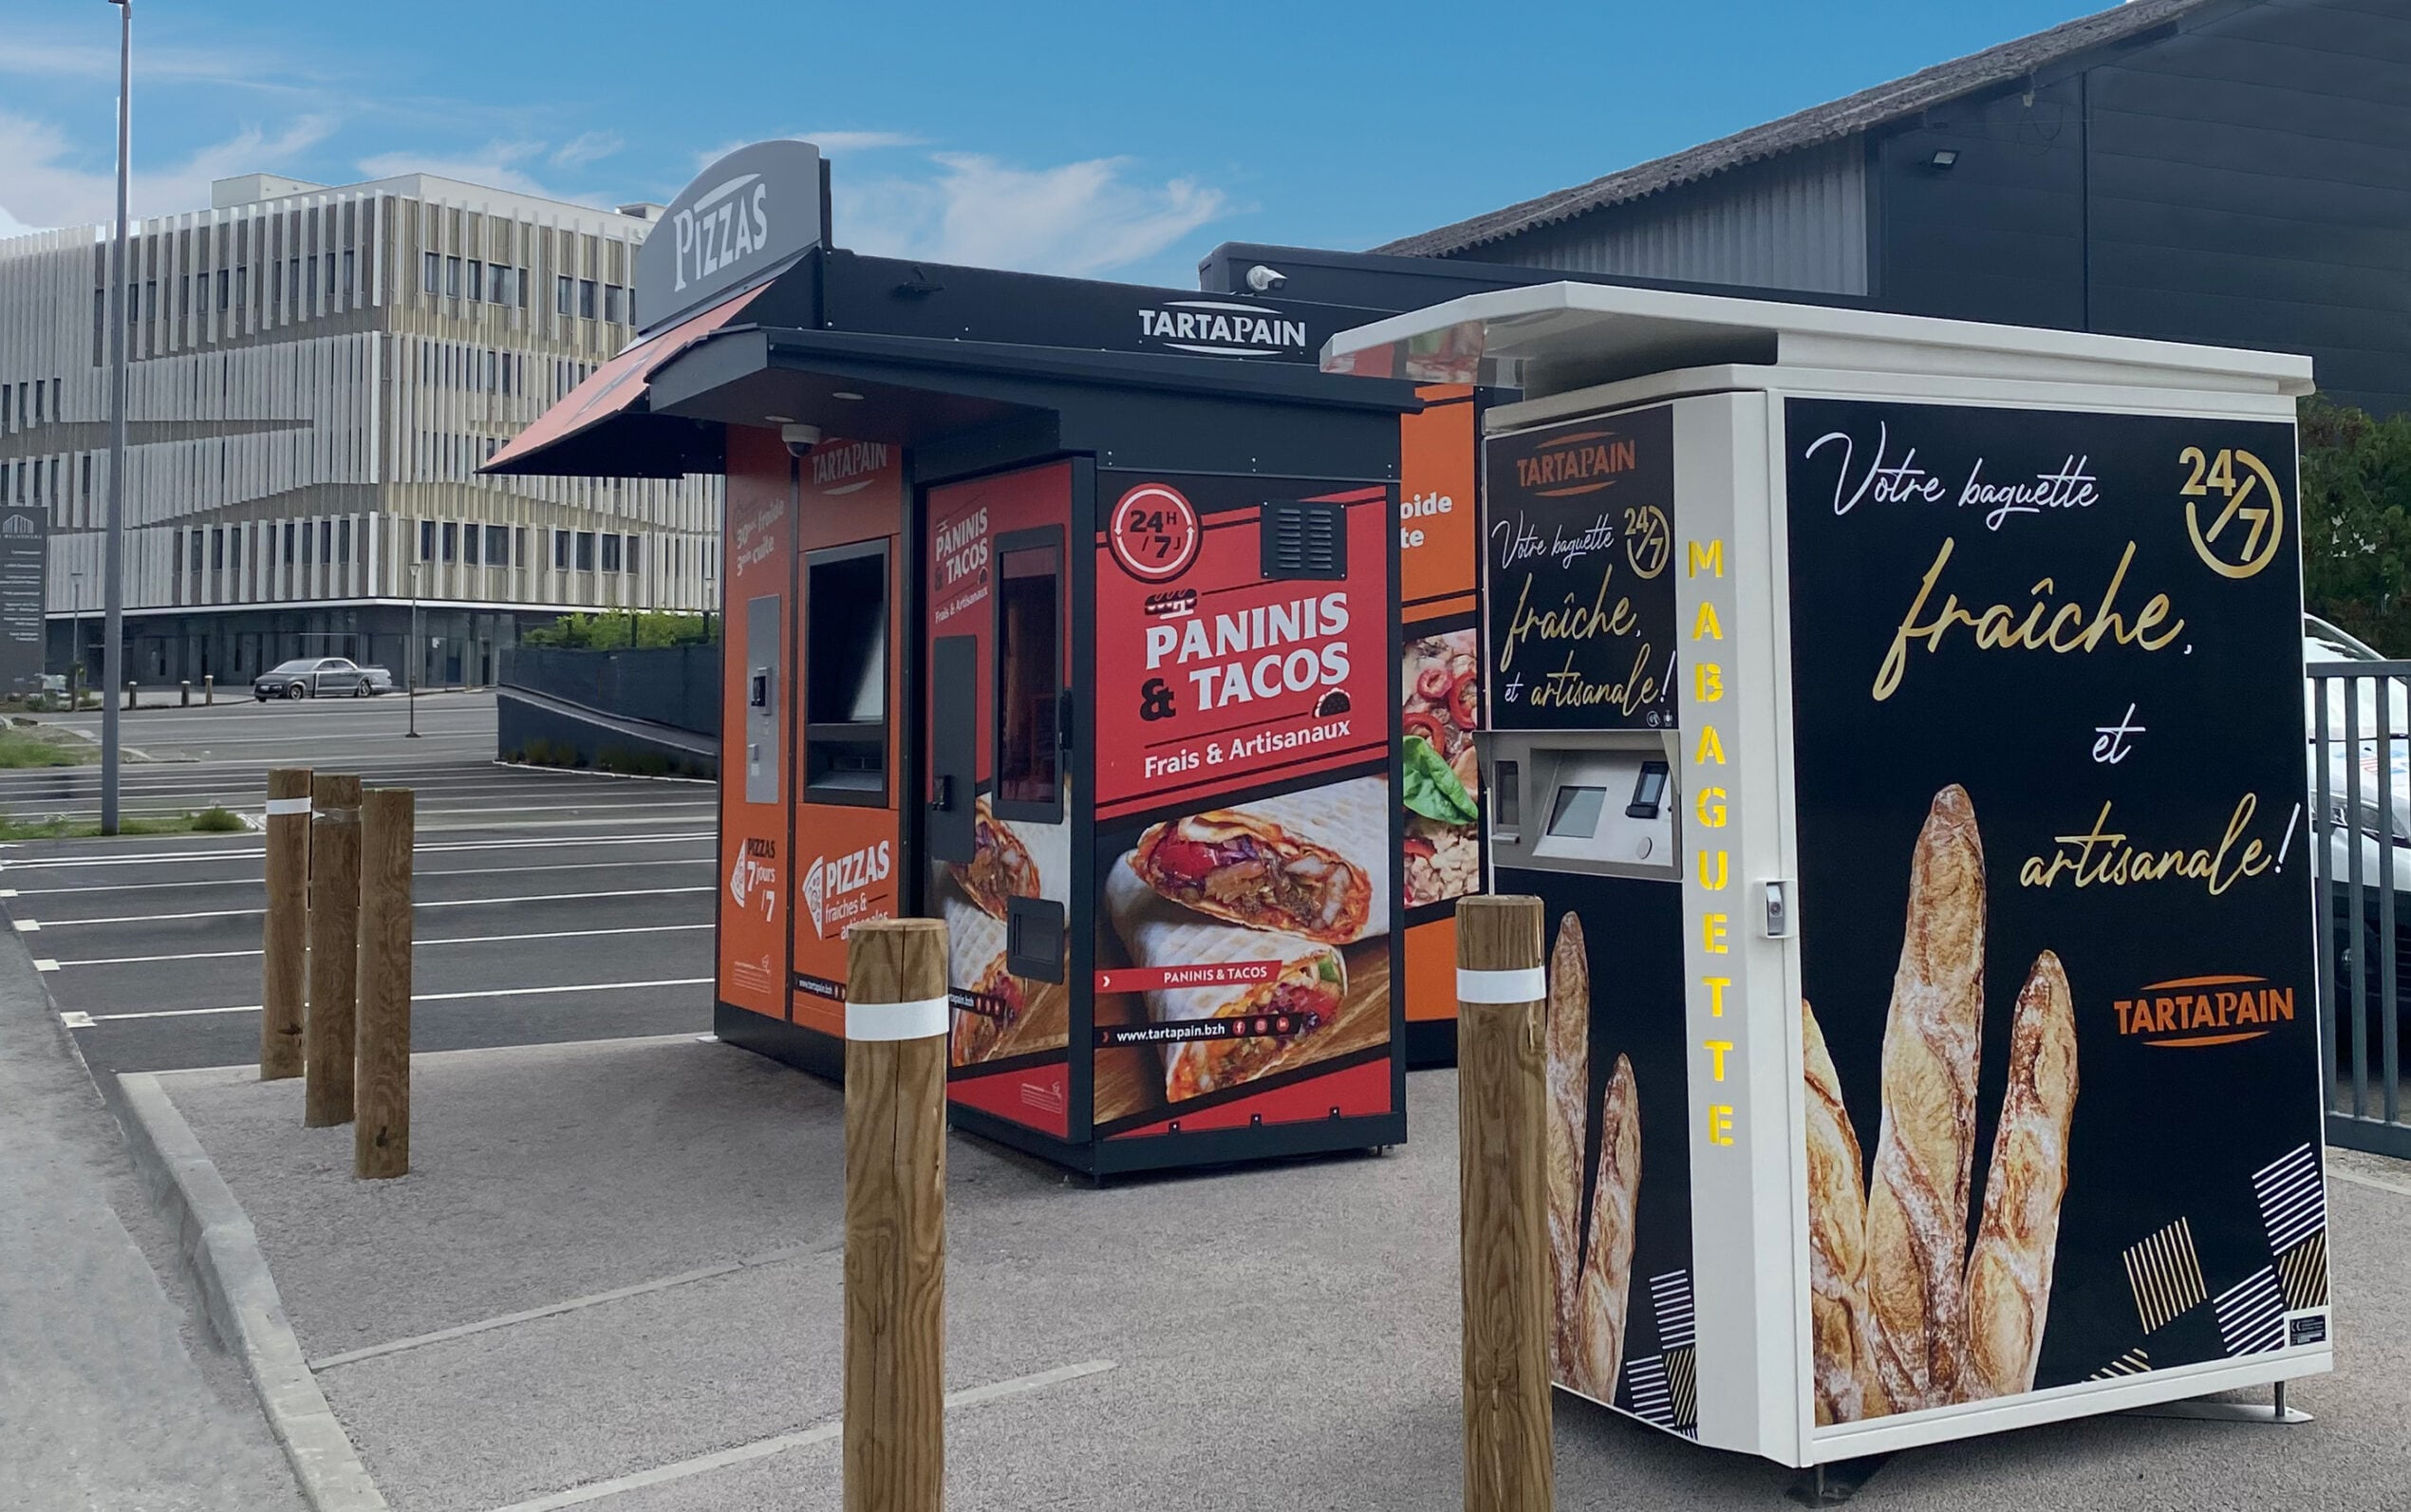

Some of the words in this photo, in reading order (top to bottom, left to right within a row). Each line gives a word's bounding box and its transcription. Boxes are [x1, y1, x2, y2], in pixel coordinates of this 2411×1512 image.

[673, 182, 767, 292] PIZZAS
[1138, 309, 1306, 347] TARTAPAIN
[813, 441, 888, 485] TARTAPAIN
[1517, 439, 1635, 488] TARTAPAIN
[1805, 420, 1946, 515] Votre
[1958, 455, 2099, 532] baguette
[936, 507, 987, 562] PANINIS
[1130, 510, 1178, 533] 24H
[1491, 510, 1547, 569] Votre
[1551, 513, 1615, 569] baguette
[946, 537, 987, 585] TACOS
[1145, 592, 1350, 670] PANINIS
[1139, 678, 1177, 721] &
[1188, 642, 1351, 712] TACOS
[1505, 672, 1523, 703] et
[1144, 749, 1200, 778] Frais
[1206, 742, 1224, 766] &
[1228, 719, 1351, 761] Artisanaux
[2092, 703, 2146, 764] et
[748, 838, 776, 859] PIZZAS
[826, 840, 890, 899] PIZZAS
[860, 892, 868, 911] &
[1164, 969, 1213, 984] PANINIS
[1217, 968, 1225, 980] &
[1227, 966, 1268, 980] TACOS
[1116, 1023, 1225, 1042] www.tartapain.bzh
[2113, 987, 2294, 1035] TARTAPAIN
